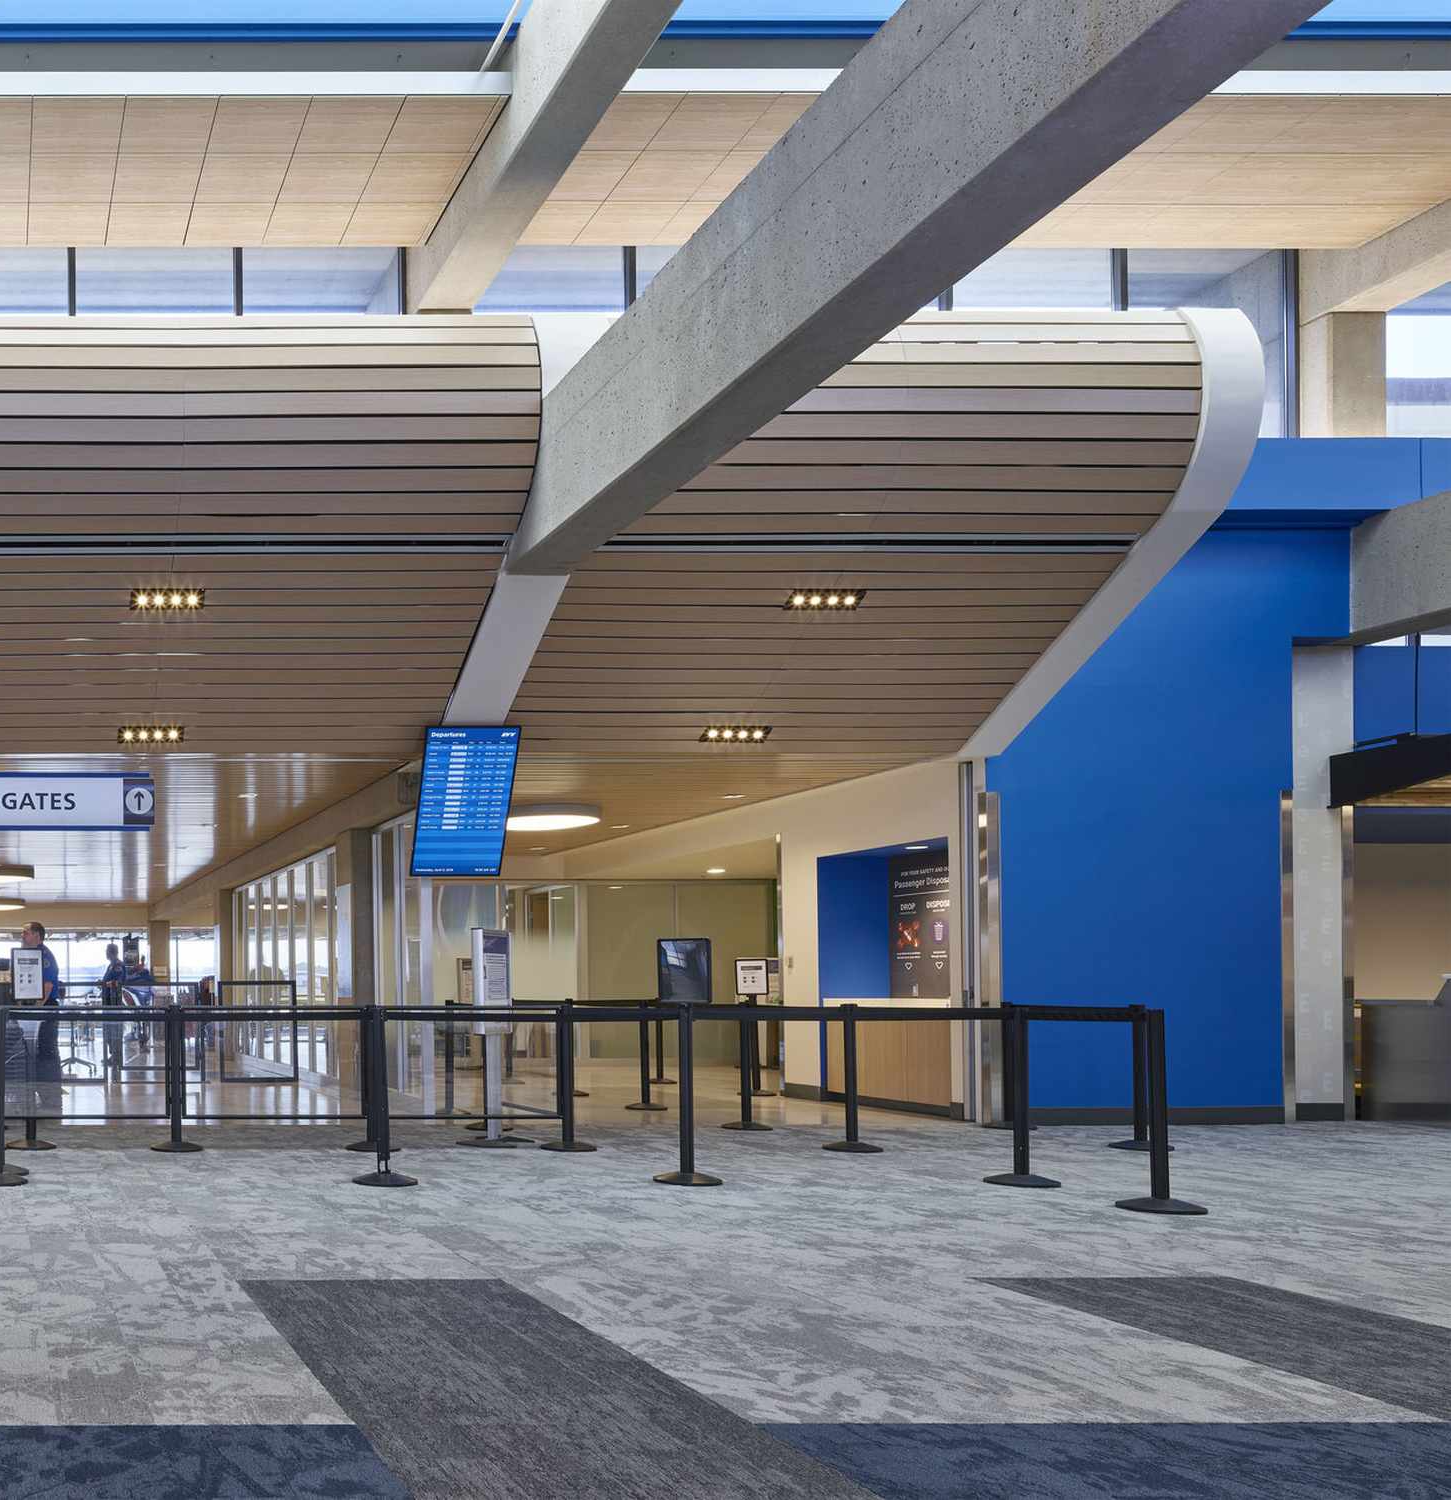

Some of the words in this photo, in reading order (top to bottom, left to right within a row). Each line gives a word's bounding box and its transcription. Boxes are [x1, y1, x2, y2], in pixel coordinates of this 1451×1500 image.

[1, 792, 76, 811] GATES
[894, 880, 925, 888] Passenger
[901, 902, 916, 911] DROP
